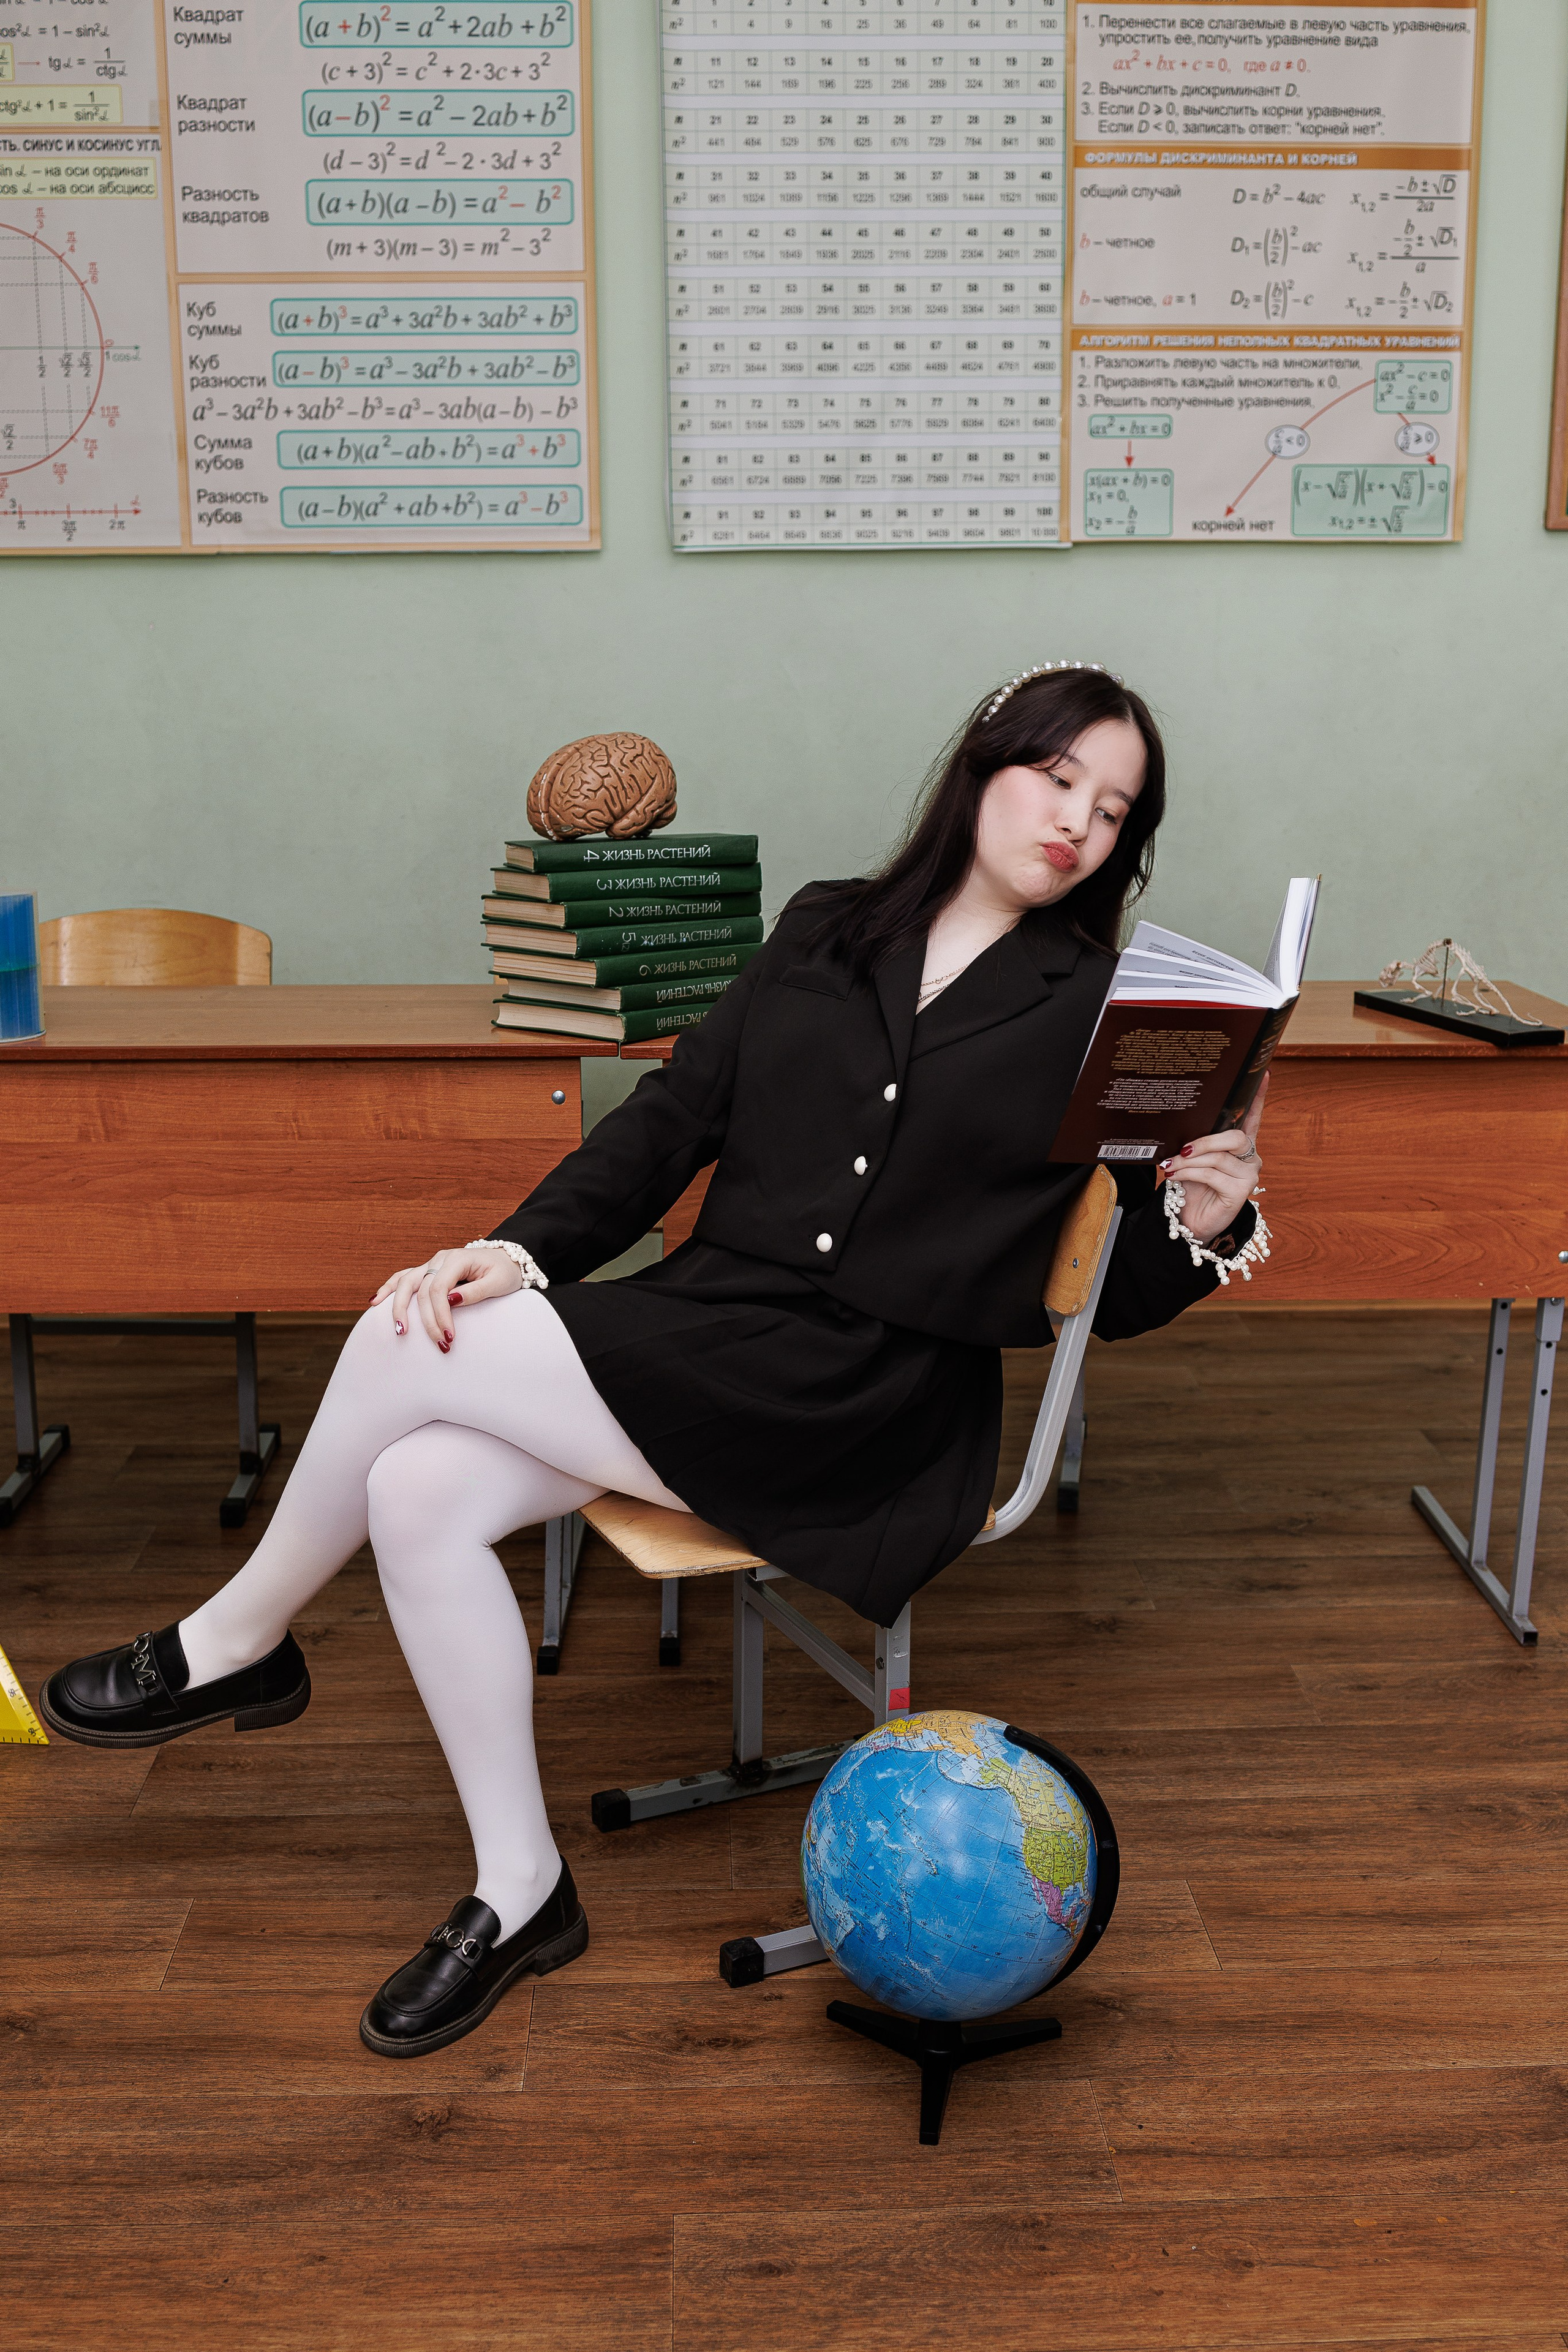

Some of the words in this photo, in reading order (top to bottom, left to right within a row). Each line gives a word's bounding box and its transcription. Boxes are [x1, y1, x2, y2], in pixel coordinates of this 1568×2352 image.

[173, 6, 244, 24] Квадрат
[1083, 14, 1095, 29] 1.
[1099, 14, 1176, 31] Перенести
[1180, 18, 1204, 29] все
[1208, 18, 1286, 30] слагаемые
[1290, 19, 1298, 29] в
[1302, 20, 1346, 33] левую
[1350, 20, 1389, 31] часть
[174, 31, 232, 46] суммы
[1099, 32, 1171, 47] упростить
[1197, 34, 1263, 48] получить
[1265, 34, 1341, 48] уравнение
[1345, 35, 1378, 48] вида
[1244, 61, 1266, 73] где
[1082, 81, 1095, 96] 2.
[1099, 81, 1178, 96] Вычислить
[1180, 85, 1281, 99] дискриминант
[177, 95, 247, 111] Квадрат
[1081, 102, 1094, 115] 3.
[1098, 102, 1134, 115] Если
[1183, 105, 1259, 116] вычислить
[1262, 106, 1303, 118] корни
[178, 119, 255, 135] разности
[1098, 119, 1134, 134] Если
[1183, 123, 1245, 134] записать
[1248, 124, 1292, 135] ответ:
[23, 138, 63, 151] СИНУС
[66, 138, 75, 151] И
[78, 138, 134, 151] КОСИНУС
[1085, 153, 1158, 164] ФОРМУЛЫ
[1161, 153, 1286, 165] ДИСКРИМИНАНТА
[1287, 153, 1298, 165] И
[1302, 151, 1359, 165] КОРНЕЙ
[44, 167, 62, 177] на
[64, 167, 89, 177] оси
[92, 166, 149, 179] ординат
[50, 184, 67, 195] на
[69, 184, 94, 195] оси
[97, 181, 156, 196] абсцисс
[182, 186, 259, 202] Разность
[1080, 184, 1128, 199] общий
[1131, 184, 1182, 200] случай
[183, 208, 269, 225] квадратов
[1106, 237, 1155, 249] четное
[187, 301, 216, 319] Куб
[187, 323, 241, 339] суммы
[1079, 336, 1150, 347] АЛГОРИТМ
[1153, 336, 1215, 347] РЕШЕНИЯ
[1218, 335, 1291, 347] НЕПОЛНЫХ
[1294, 336, 1381, 349] КВАДРАТНЫХ
[1385, 334, 1460, 347] УРАВНЕНИЙ
[189, 355, 220, 372] Куб
[1095, 355, 1170, 369] Разложить
[1173, 358, 1217, 372] левую
[1219, 358, 1259, 369] часть
[1262, 358, 1279, 369] на
[190, 375, 266, 391] разности
[1094, 375, 1178, 391] Приравнять
[1181, 375, 1234, 390] каждый
[1238, 377, 1314, 388] множитель
[1317, 377, 1324, 388] к
[1094, 394, 1147, 408] Решить
[1150, 396, 1234, 411] полученные
[194, 435, 252, 453] Сумма
[195, 456, 244, 474] кубов
[197, 489, 268, 505] Разность
[198, 510, 242, 526] кубов
[1193, 516, 1245, 533] корней
[1250, 519, 1275, 532] нет
[584, 850, 600, 862] 4
[603, 850, 644, 861] ЖИЗНЬ
[647, 845, 711, 859] РАСТЕНИЙ
[597, 879, 612, 890] 3
[615, 878, 656, 890] ЖИЗНЬ
[660, 872, 720, 888] РАСТЕНИЙ
[609, 907, 624, 918] 2
[626, 905, 663, 917] ЖИЗНЬ
[665, 900, 722, 915] РАСТЕНИЙ
[622, 932, 636, 942] 5
[641, 934, 676, 946] ЖИЗНЬ
[679, 926, 732, 943] РАСТЕНИЙ
[639, 965, 651, 976] 6
[654, 961, 687, 974] ЖИЗНЬ
[689, 954, 736, 970] РАСТЕНИЙ
[657, 984, 704, 1003] РАСТЕНИЙ
[657, 1012, 701, 1031] РАСТЕНИЙ
